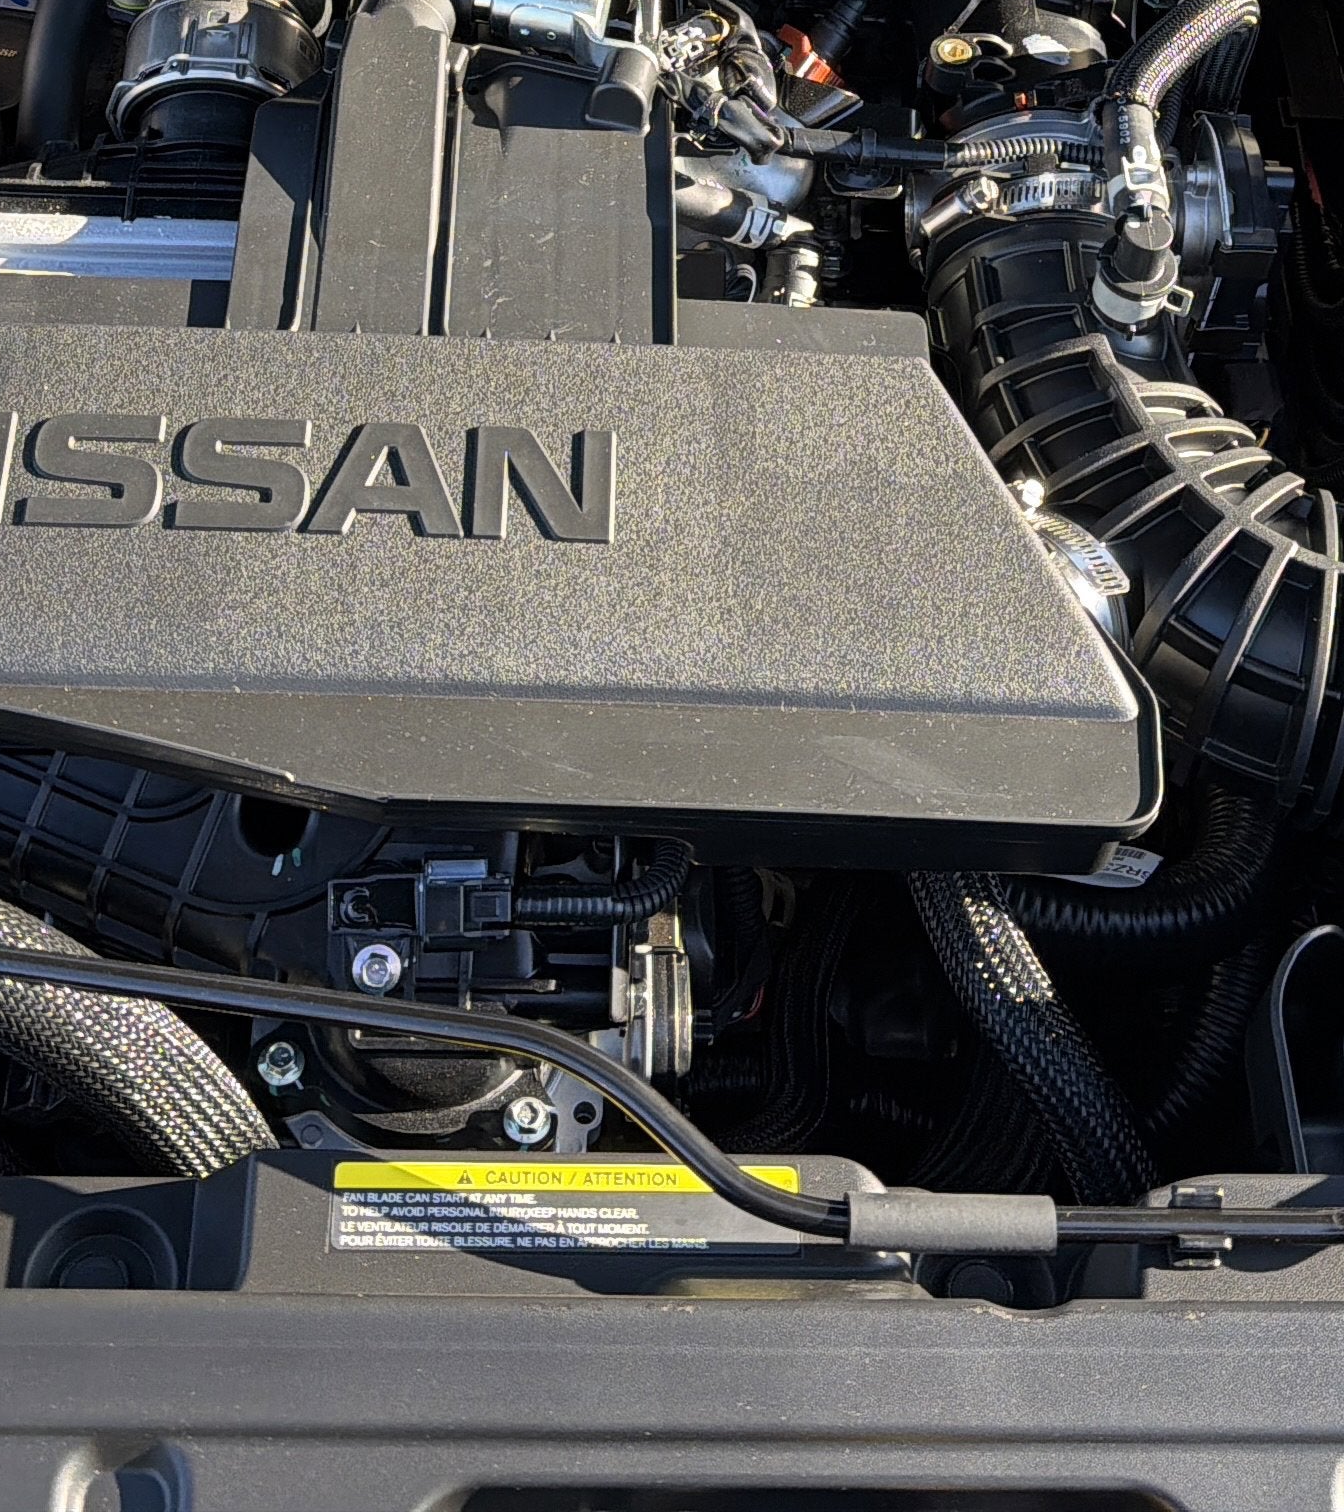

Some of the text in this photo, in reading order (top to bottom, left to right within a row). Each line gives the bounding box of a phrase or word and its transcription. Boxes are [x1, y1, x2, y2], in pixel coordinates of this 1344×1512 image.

[485, 1170, 677, 1186] CAUTION / ATTENTION
[343, 1192, 537, 1205] FAN BLADE CAN START AT ANY TIME.
[342, 1205, 357, 1217] TO
[359, 1206, 389, 1217] HELP
[390, 1206, 425, 1217] AVOID
[427, 1206, 486, 1218] PERSONAL
[556, 1207, 598, 1219] HANDS
[598, 1207, 640, 1220] CLEAR.
[341, 1221, 356, 1233] LE
[356, 1221, 429, 1233] VENTILATEUR
[431, 1222, 473, 1233] RISQUE
[476, 1223, 492, 1233] DE
[555, 1220, 567, 1234] À
[567, 1223, 597, 1234] TOUT
[598, 1223, 650, 1235] MOMENT.
[339, 1235, 373, 1247] POUR
[375, 1233, 413, 1247] ÉVITER
[415, 1235, 451, 1247] TOUTE
[453, 1236, 515, 1248] BLESSURE,
[517, 1237, 532, 1247] NE
[534, 1237, 557, 1248] PAS
[559, 1237, 574, 1248] EN
[578, 1237, 646, 1249] APPROCHER
[648, 1239, 669, 1249] LES
